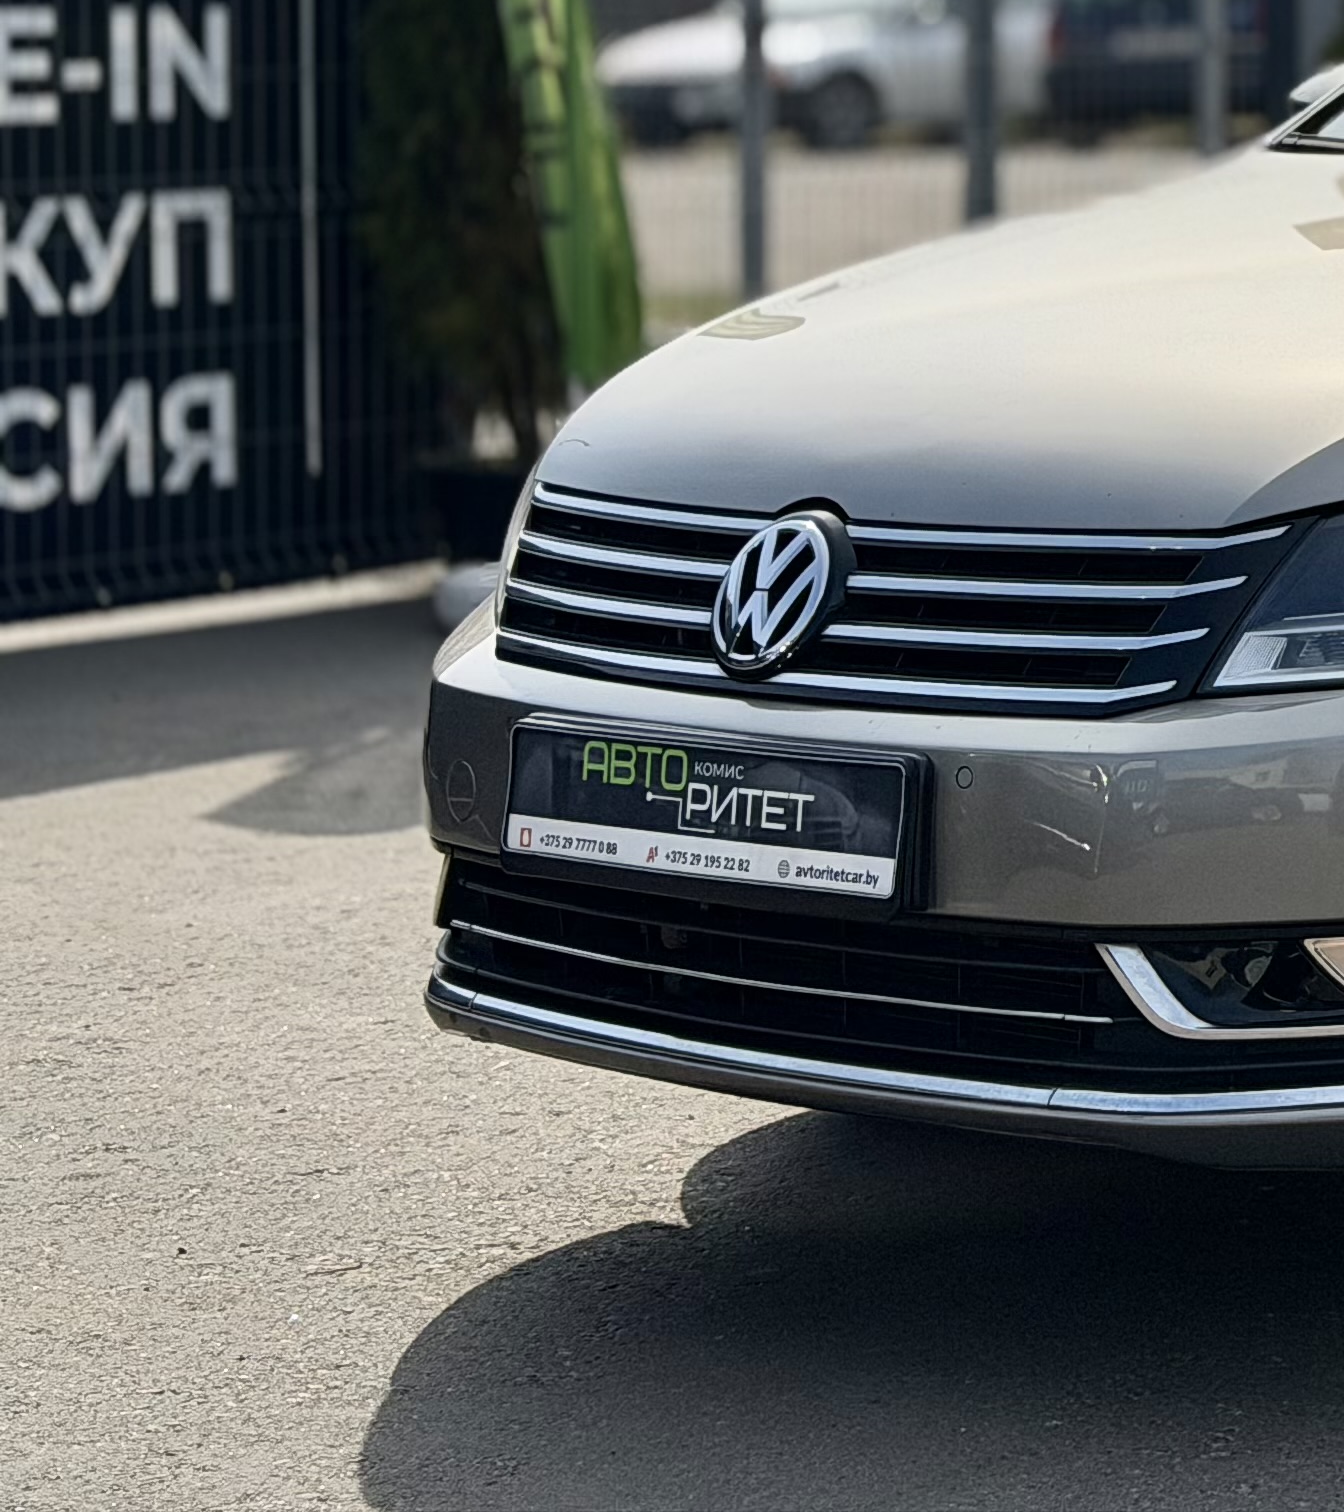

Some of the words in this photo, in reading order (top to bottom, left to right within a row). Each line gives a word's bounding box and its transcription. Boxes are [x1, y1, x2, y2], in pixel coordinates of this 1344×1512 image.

[0, 3, 231, 130] E-IN
[0, 187, 234, 317] КУП
[0, 372, 238, 512] СИЯ
[582, 741, 688, 791] АВТО
[685, 782, 815, 832] РИТЕТ
[539, 834, 561, 847] +375
[562, 836, 573, 849] 29
[575, 838, 597, 851] 7777
[665, 850, 688, 864] +375
[690, 853, 702, 866] 29
[704, 854, 721, 868] 195
[723, 857, 736, 871] 22
[738, 858, 750, 872] 82
[795, 864, 880, 889] avtoritetcar.by
